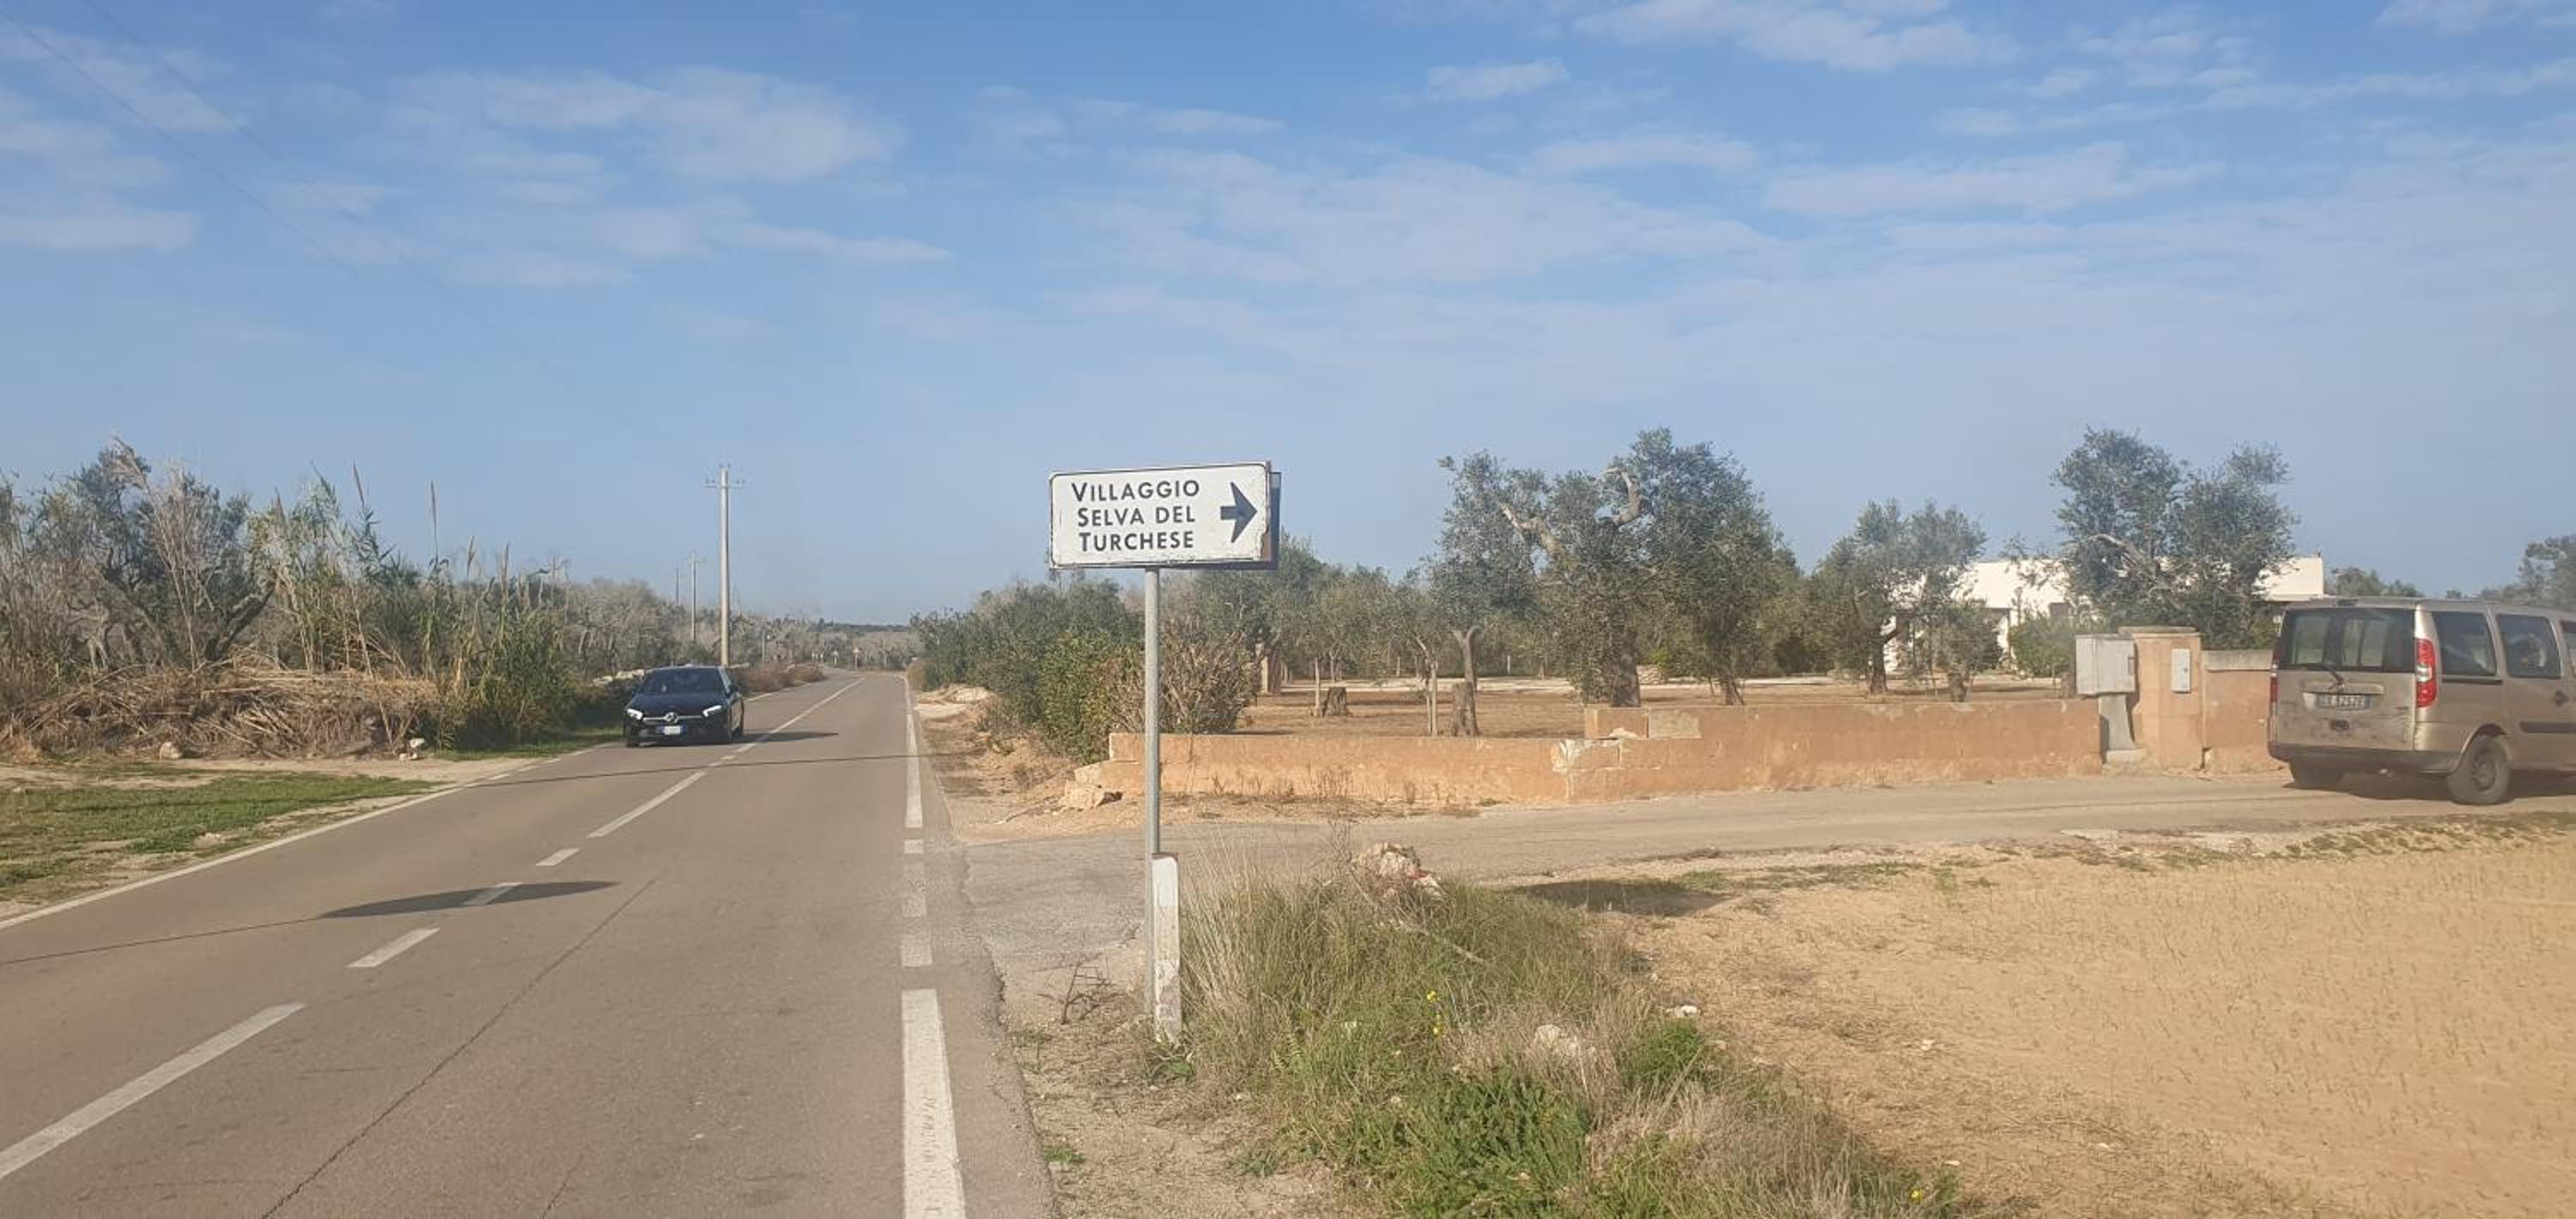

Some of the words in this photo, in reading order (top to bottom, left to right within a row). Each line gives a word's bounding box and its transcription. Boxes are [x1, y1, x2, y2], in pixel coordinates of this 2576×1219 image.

[1071, 480, 1200, 502] VILLAGGIO
[1077, 506, 1145, 528] SELVA
[1154, 505, 1196, 525] DEL
[1078, 531, 1194, 553] TURCHESE
